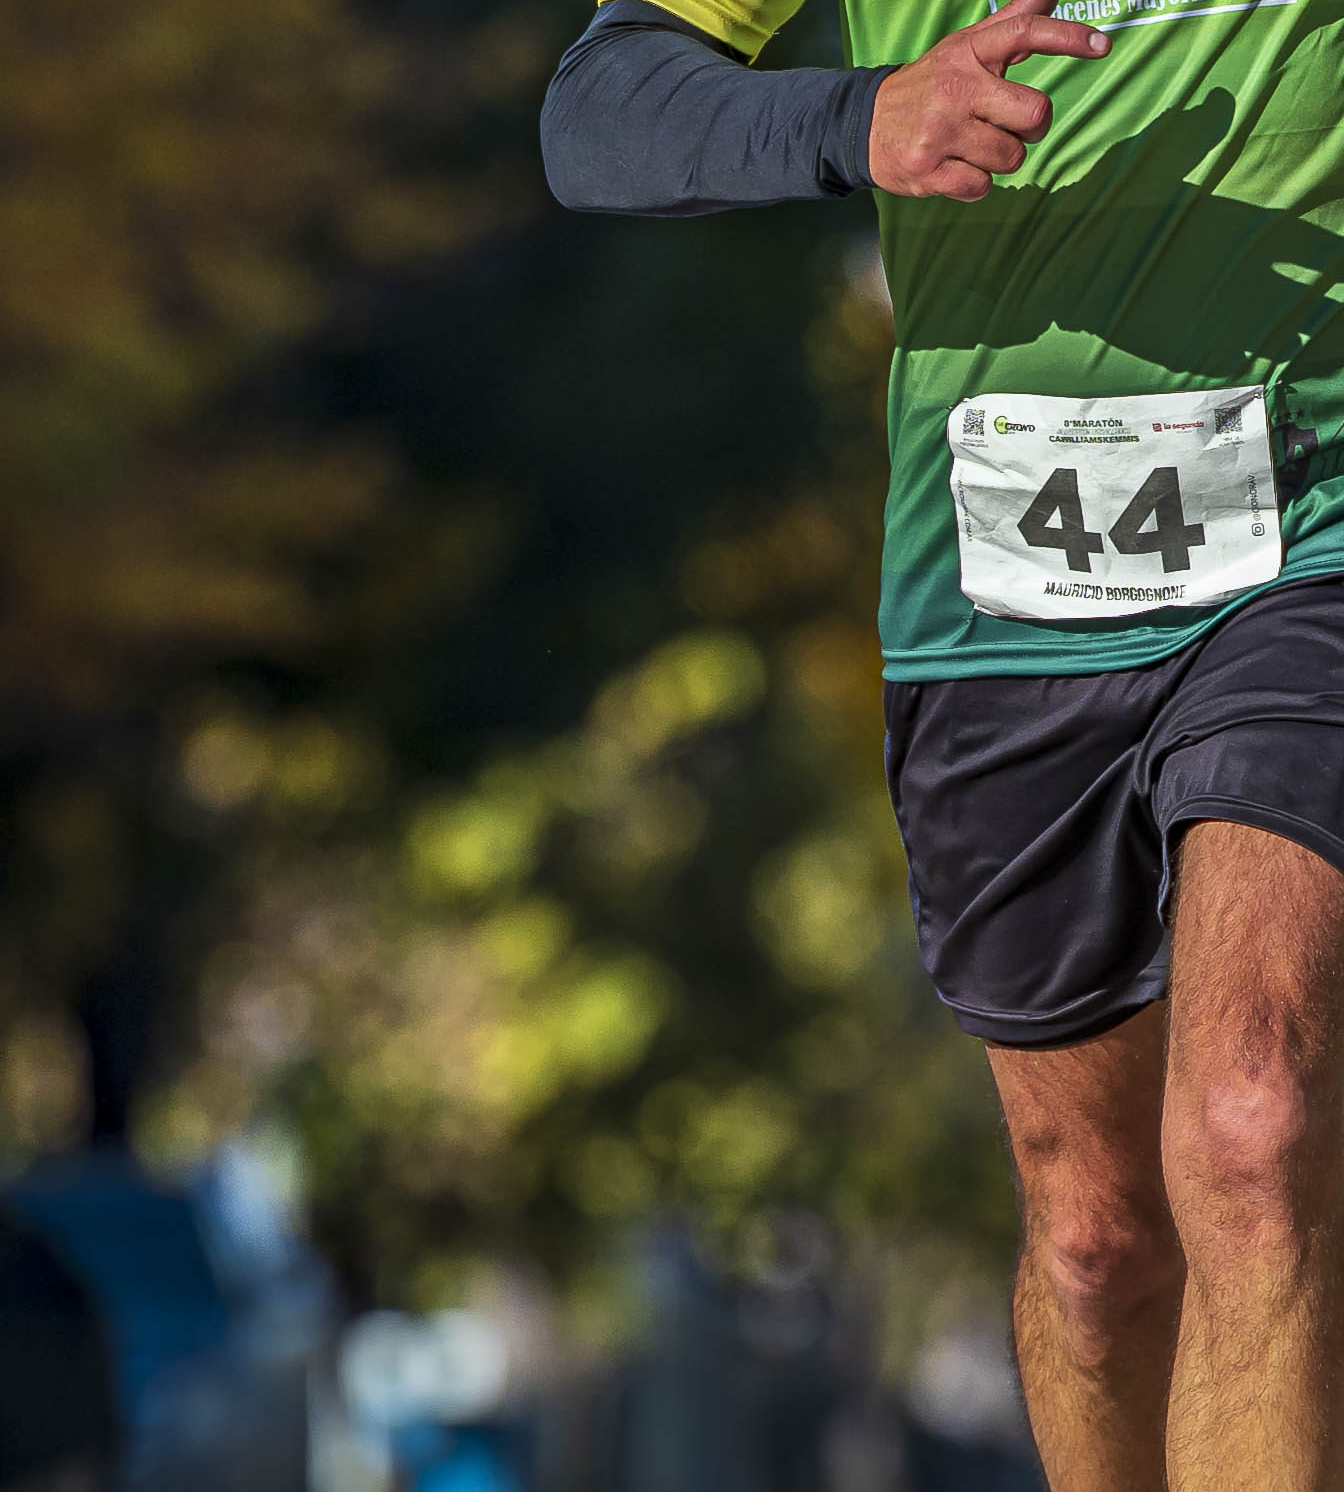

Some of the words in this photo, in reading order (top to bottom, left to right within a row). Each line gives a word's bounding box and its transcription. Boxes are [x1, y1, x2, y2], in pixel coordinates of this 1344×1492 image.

[1017, 467, 1207, 574] 44
[1044, 581, 1103, 601] MAURICIO
[1105, 584, 1187, 602] BORGOGNONE
